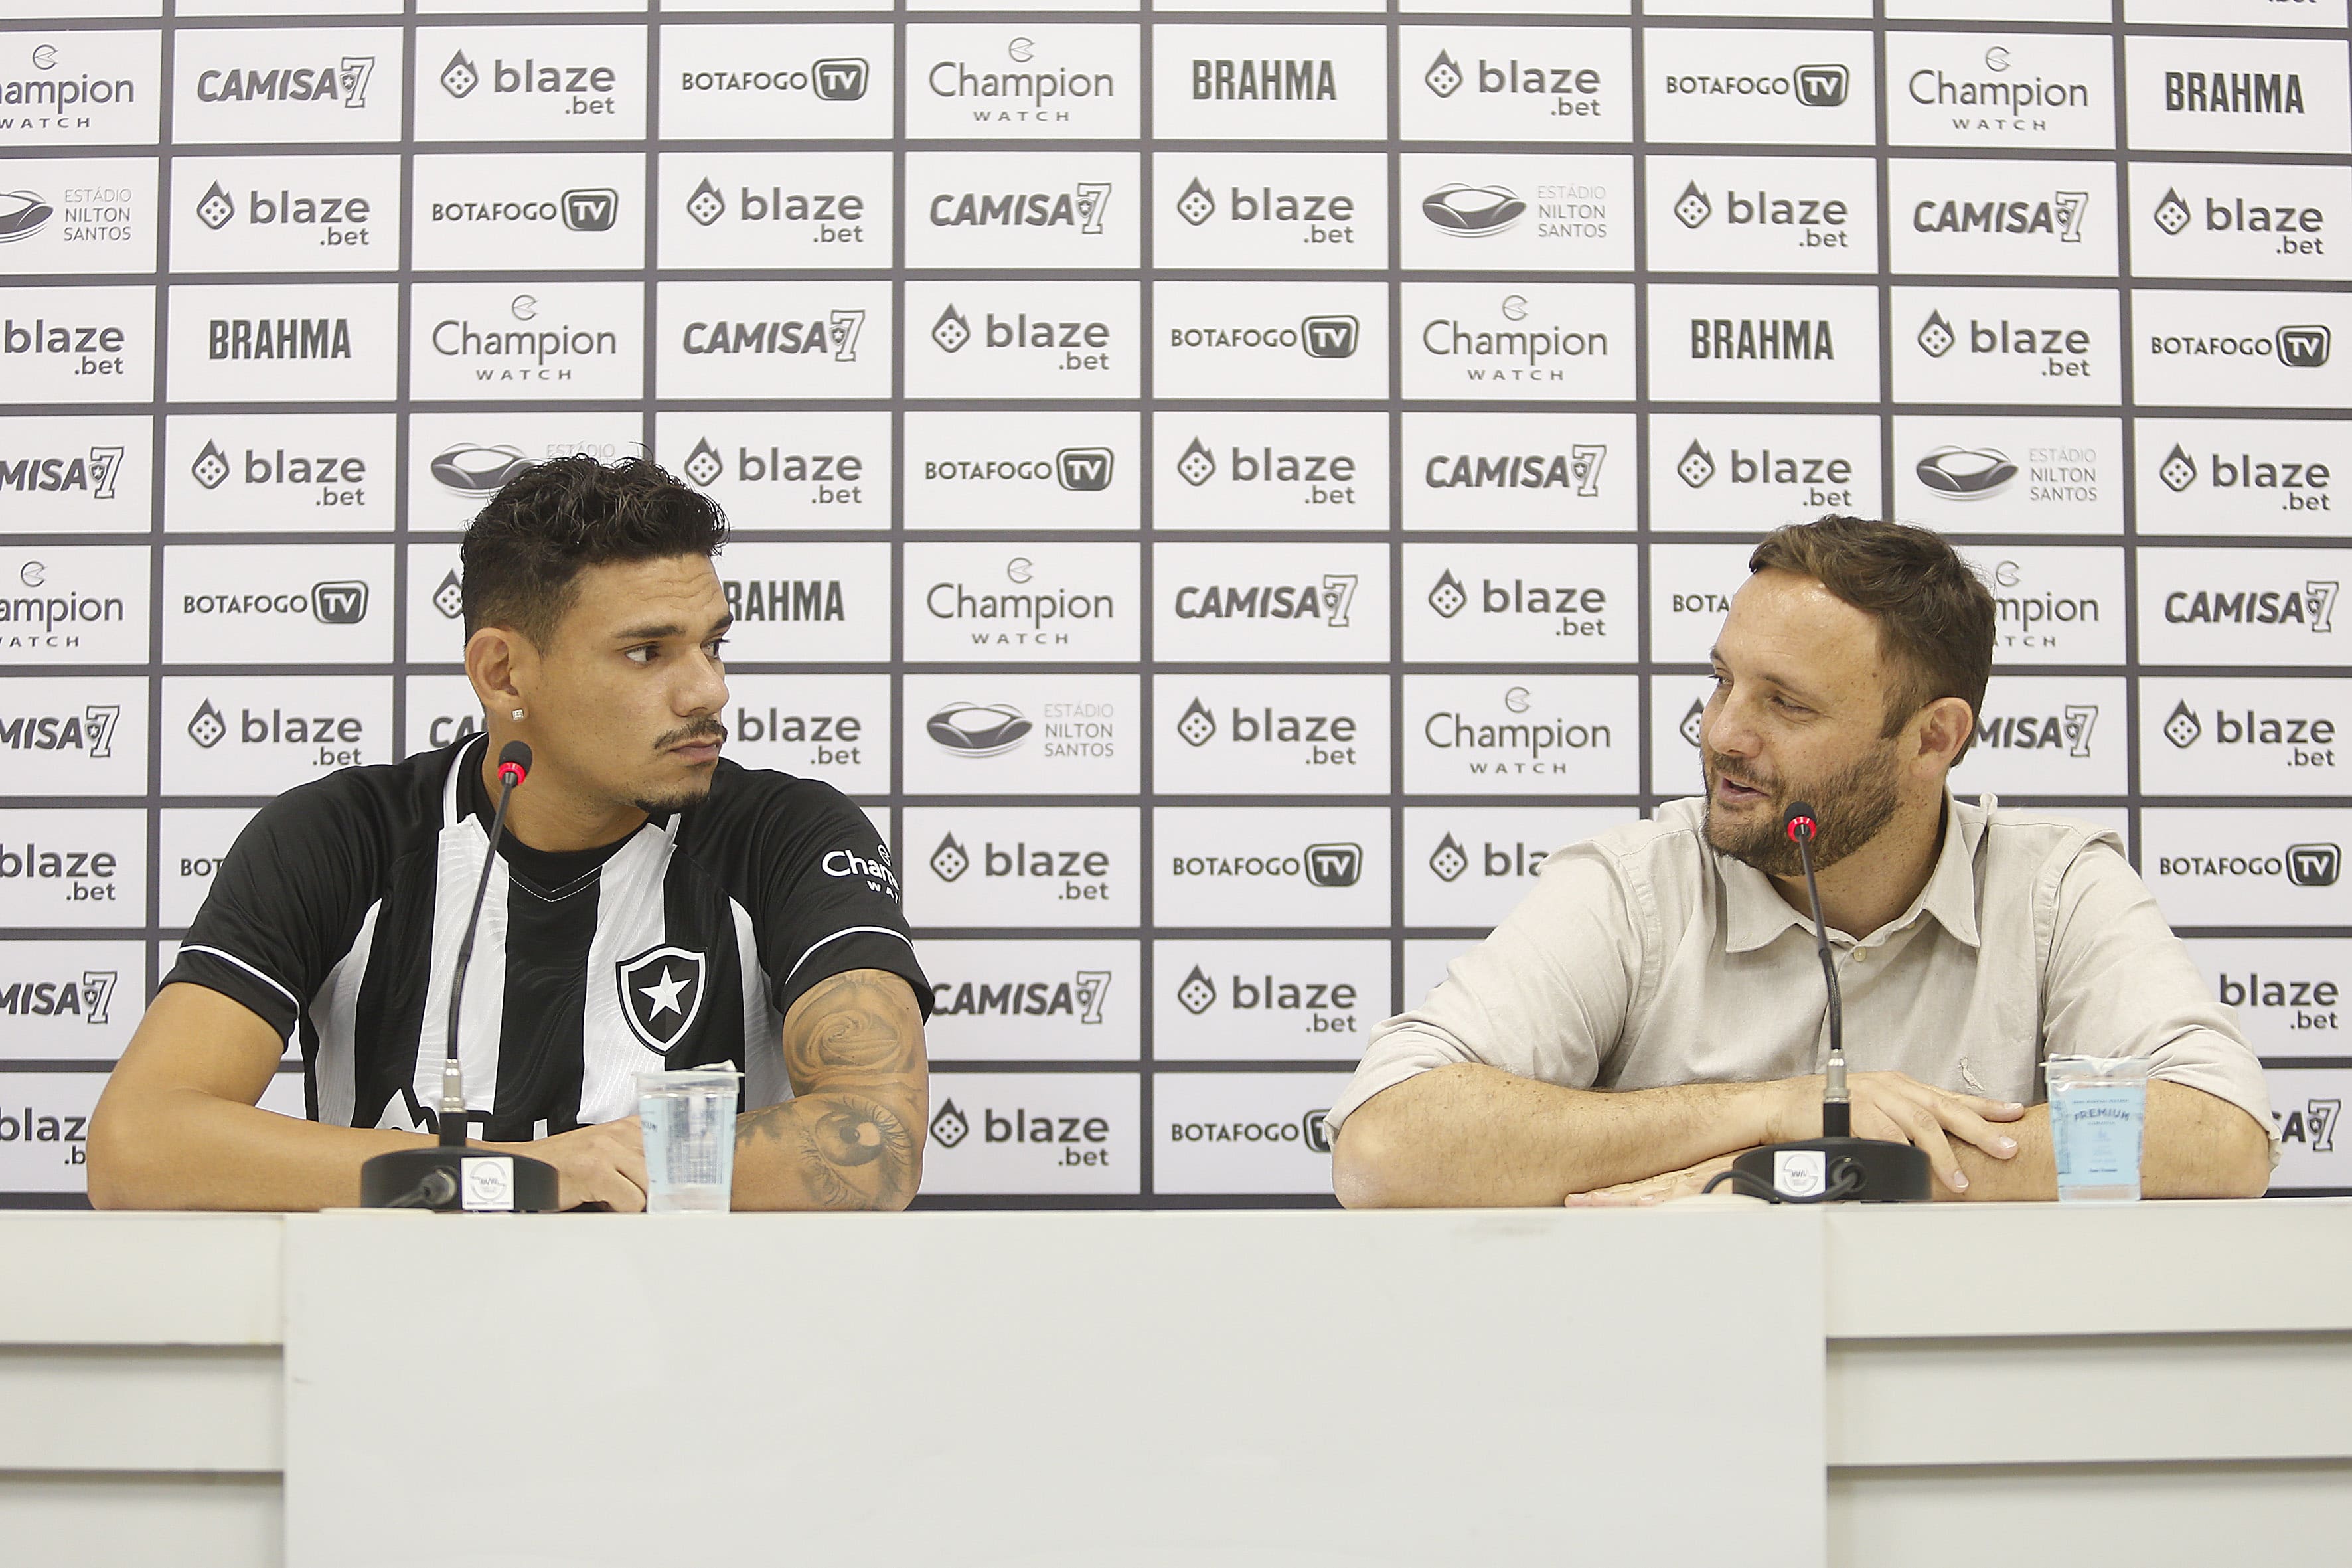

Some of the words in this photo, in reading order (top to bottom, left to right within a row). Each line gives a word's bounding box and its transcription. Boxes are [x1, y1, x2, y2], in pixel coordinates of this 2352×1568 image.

[495, 59, 615, 92] blaze
[682, 72, 807, 90] BOTAFOGO
[823, 70, 858, 90] TV
[929, 62, 1113, 107] Champion
[1193, 60, 1336, 100] BRAHMA
[1480, 60, 1600, 94] blaze
[0, 74, 133, 114] ampion
[1666, 76, 1790, 95] BOTAFOGO
[1804, 76, 1838, 96] TV
[1909, 70, 2088, 116] Champion
[2165, 72, 2305, 114] BRAHMA
[566, 96, 615, 114] .bet
[1551, 97, 1601, 116] .bet
[0, 117, 90, 129] WATCH
[973, 111, 1069, 122] WATCH
[1952, 119, 2045, 131] WATCH
[64, 188, 132, 203] ESTÁDIO
[1537, 185, 1606, 200] ESTÁDIO
[250, 190, 370, 224] blaze
[433, 202, 557, 221] BOTAFOGO
[572, 201, 607, 221] TV
[742, 187, 864, 220] blaze
[1232, 187, 1354, 221] blaze
[1540, 205, 1604, 218] NILTON
[1728, 191, 1848, 225] blaze
[66, 208, 129, 222] NILTON
[2206, 198, 2323, 232] blaze
[64, 226, 130, 241] SANTOS
[321, 226, 369, 245] .bet
[814, 224, 863, 242] .bet
[1304, 224, 1354, 243] .bet
[1539, 224, 1606, 238] SANTOS
[1799, 228, 1848, 247] .bet
[2276, 235, 2324, 254] .bet
[5, 319, 124, 353] blaze
[210, 319, 351, 360] BRAHMA
[987, 314, 1109, 347] blaze
[1172, 329, 1297, 347] BOTAFOGO
[1312, 328, 1348, 348] TV
[1691, 319, 1834, 360] BRAHMA
[1971, 320, 2090, 354] blaze
[433, 320, 616, 366] Champion
[1423, 319, 1607, 366] Champion
[2152, 337, 2272, 355] BOTAFOGO
[2287, 337, 2319, 357] TV
[74, 356, 123, 374] .bet
[1059, 351, 1109, 370] .bet
[2042, 358, 2090, 376] .bet
[476, 369, 571, 380] WATCH
[1467, 369, 1563, 381] WATCH
[740, 447, 862, 481] blaze
[1233, 447, 1355, 481] blaze
[2029, 447, 2096, 463] ESTÁDIO
[0, 446, 124, 499] MISA7
[246, 449, 366, 483] blaze
[925, 461, 1052, 479] BOTAFOGO
[1067, 460, 1102, 480] TV
[1731, 449, 1851, 484] blaze
[2031, 468, 2095, 482] NILTON
[2213, 454, 2330, 488] blaze
[316, 487, 365, 505] .bet
[812, 485, 862, 503] .bet
[1305, 485, 1355, 504] .bet
[1803, 487, 1852, 507] .bet
[2031, 487, 2096, 501] SANTOS
[2282, 492, 2330, 510] .bet
[184, 595, 307, 613] BOTAFOGO
[323, 593, 356, 614] TV
[723, 580, 845, 621] RAHMA
[927, 582, 1113, 629] Champion
[1484, 579, 1606, 613] blaze
[1673, 594, 1729, 612] BOTA
[0, 591, 123, 633] ampion
[1996, 591, 2099, 632] mpion
[1556, 617, 1606, 636] .bet
[0, 635, 80, 648] ATCH
[971, 633, 1068, 645] WATCH
[2003, 635, 2057, 647] TCH
[1044, 703, 1114, 718] ESTÁDIO
[0, 705, 120, 757] MISA7
[242, 709, 362, 743] blaze
[738, 708, 862, 742] blaze
[1046, 724, 1112, 738] NILTON
[1233, 708, 1356, 742] blaze
[1970, 705, 2099, 757] MISA7
[2217, 710, 2335, 744] blaze
[1425, 712, 1610, 759] Champion
[313, 746, 362, 765] .bet
[811, 745, 860, 765] .bet
[1046, 743, 1113, 756] SANTOS
[1306, 745, 1356, 765] .bet
[2288, 747, 2335, 767] .bet
[1470, 763, 1566, 774] WATCH
[0, 844, 116, 878] blaze
[986, 842, 1109, 876] blaze
[1174, 857, 1300, 876] BOTAFOGO
[1316, 856, 1350, 876] TV
[1485, 842, 1549, 877] bla
[2160, 858, 2282, 875] BOTAFOGO
[2297, 856, 2329, 876] TV
[822, 850, 900, 890] Cham
[66, 882, 116, 900] .bet
[1059, 880, 1109, 900] .bet
[1233, 975, 1356, 1009] blaze
[2220, 973, 2339, 1007] blaze
[1306, 1013, 1356, 1032] .bet
[2290, 1010, 2338, 1029] .bet
[0, 1107, 86, 1141] blaz
[985, 1109, 1109, 1143] blaze
[1172, 1123, 1299, 1142] BOTAFOGO
[64, 1145, 86, 1164] .b
[1059, 1146, 1109, 1166] .bet
